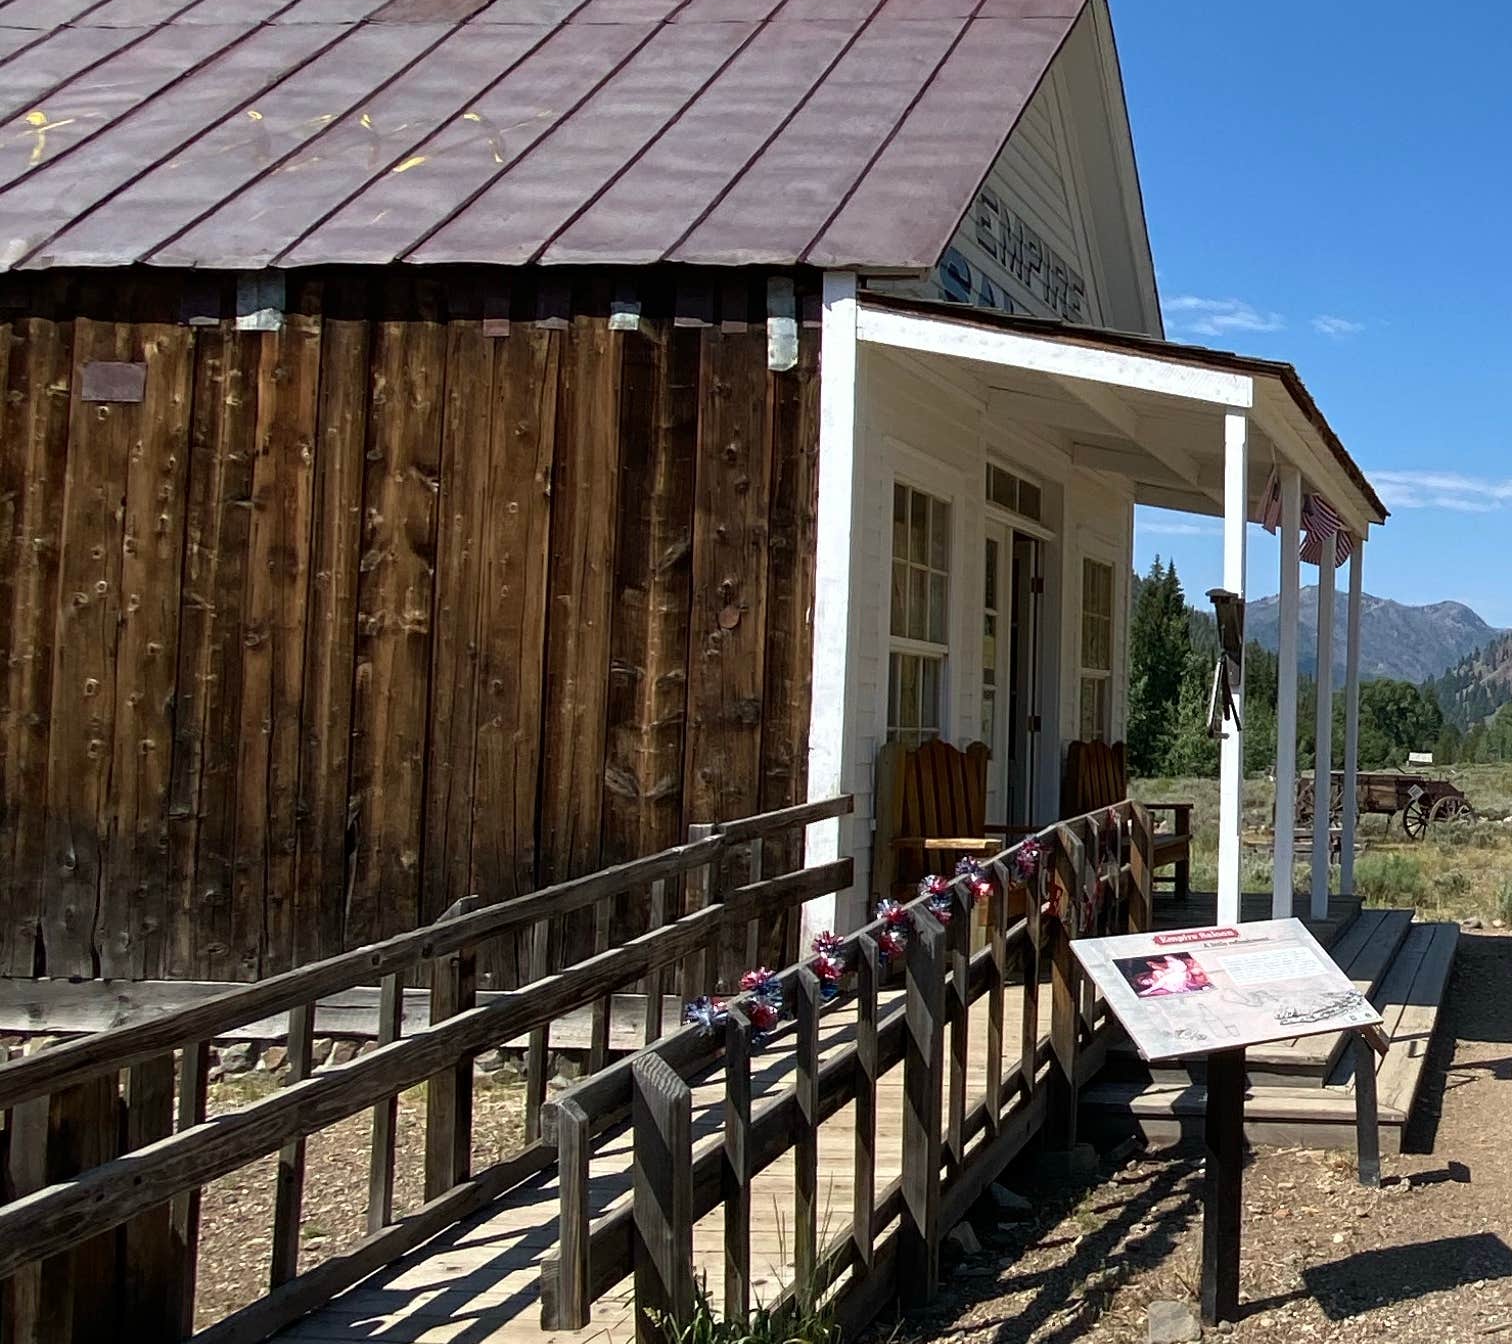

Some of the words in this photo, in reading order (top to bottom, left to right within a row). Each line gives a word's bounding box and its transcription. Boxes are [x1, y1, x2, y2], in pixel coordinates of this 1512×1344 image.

[976, 193, 1086, 324] EMPIRE
[1158, 933, 1198, 943] Empire
[1199, 930, 1235, 940] Saloon
